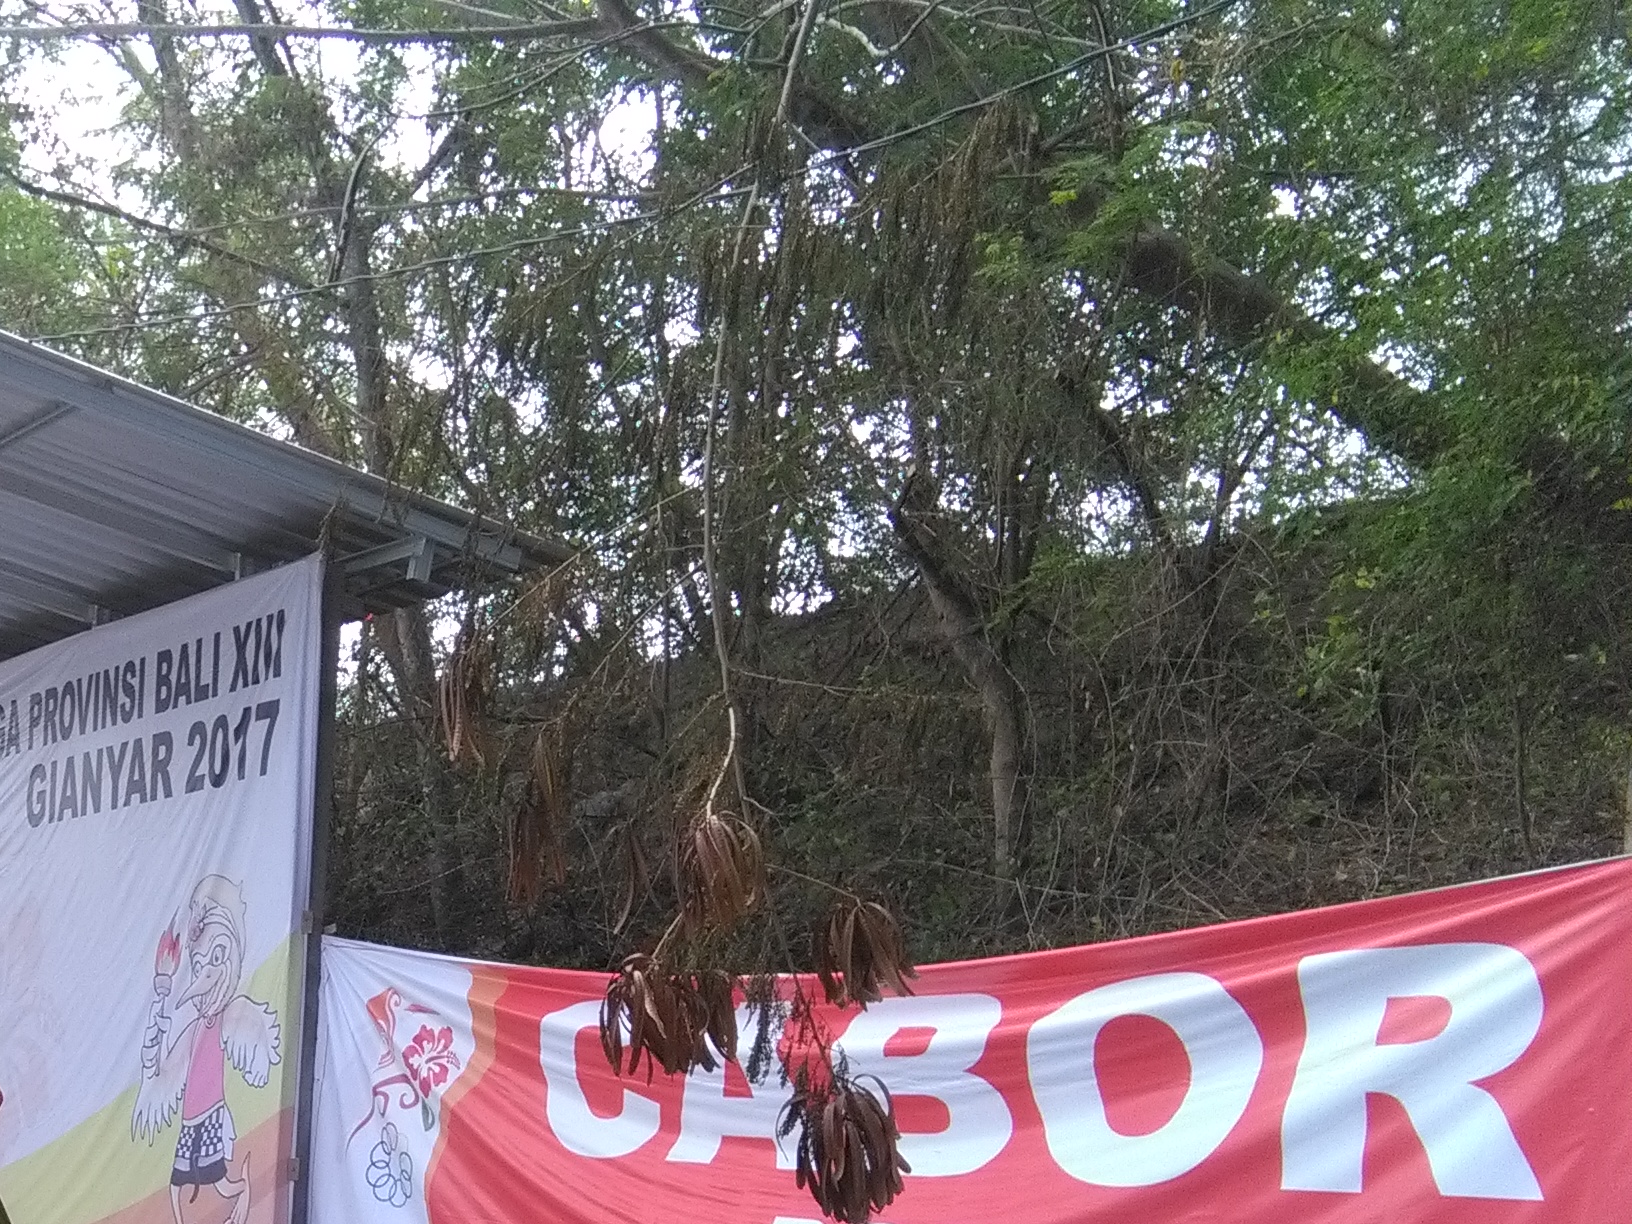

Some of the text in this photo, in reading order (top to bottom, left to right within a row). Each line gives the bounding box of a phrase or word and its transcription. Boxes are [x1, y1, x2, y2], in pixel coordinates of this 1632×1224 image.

[28, 656, 146, 750] PROVINSI
[154, 632, 221, 714] BALI
[229, 609, 285, 693] XIII
[27, 699, 280, 828] GIANYAR 2017
[540, 942, 1545, 1201] CABOR
